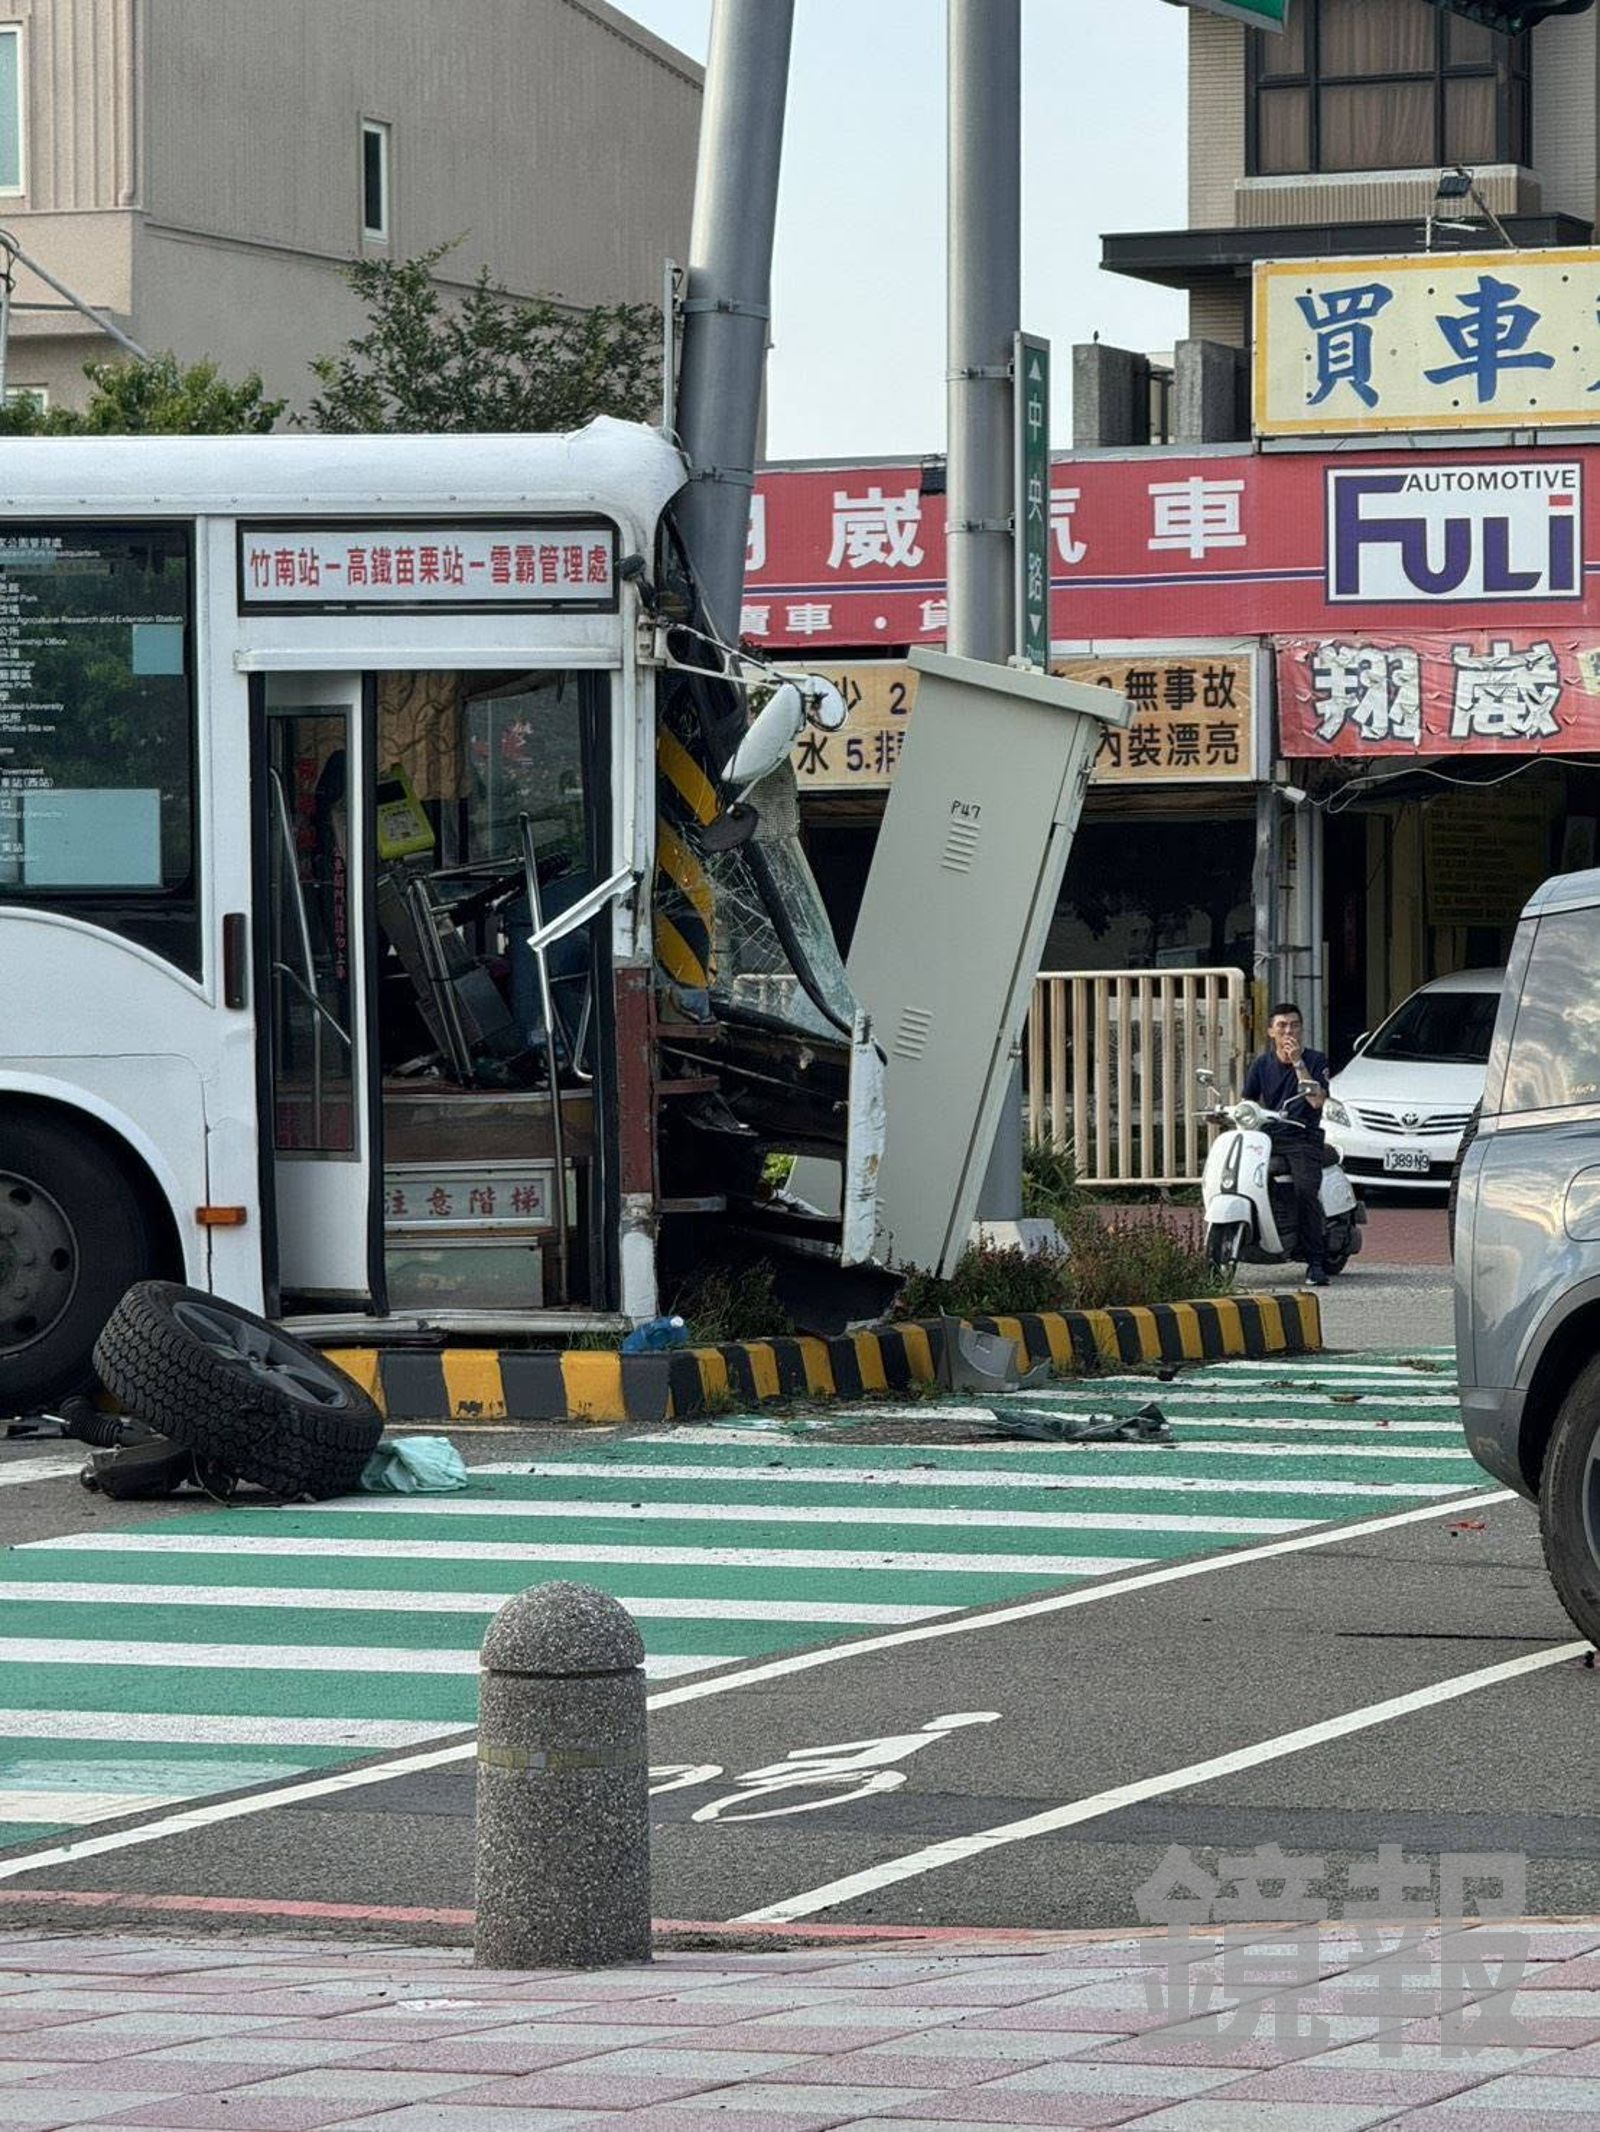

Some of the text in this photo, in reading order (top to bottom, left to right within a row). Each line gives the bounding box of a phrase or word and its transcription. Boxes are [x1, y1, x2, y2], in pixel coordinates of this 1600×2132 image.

[1295, 274, 1600, 408] 買車
[1406, 469, 1577, 493] AUTOMOTIVE
[1027, 392, 1043, 602] 中央路
[951, 799, 981, 819] P47
[385, 1186, 540, 1216] 注意階梯
